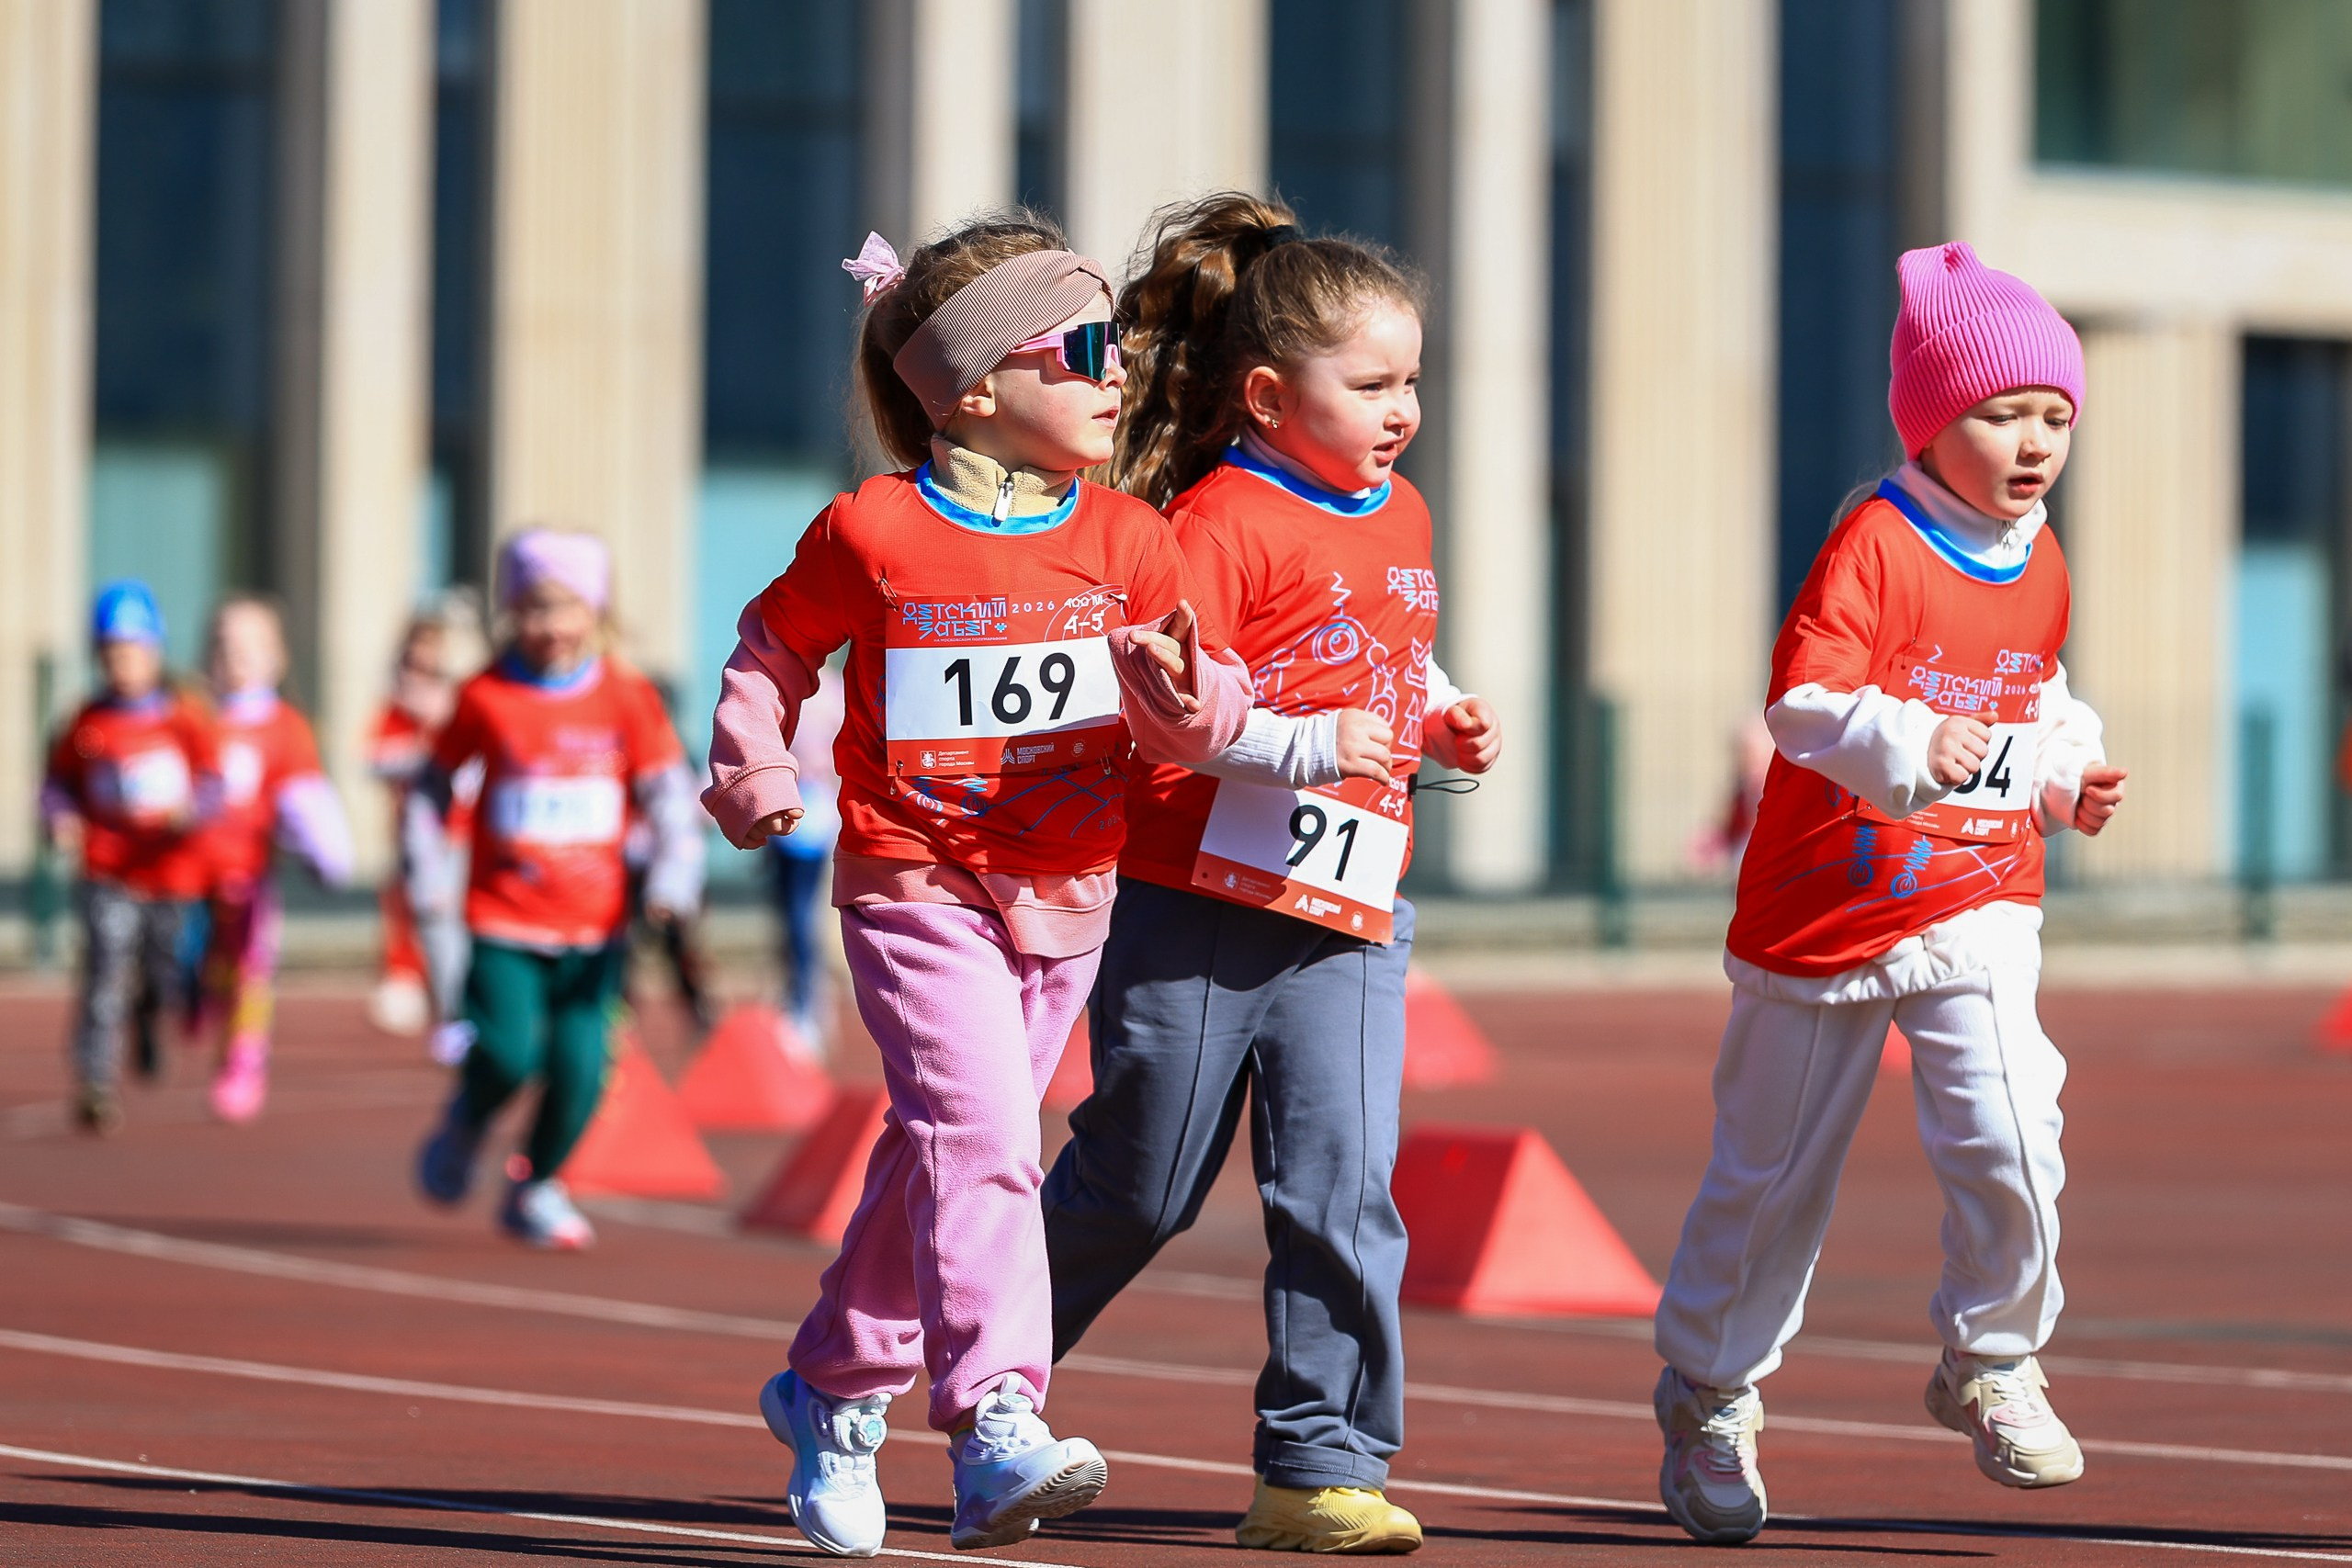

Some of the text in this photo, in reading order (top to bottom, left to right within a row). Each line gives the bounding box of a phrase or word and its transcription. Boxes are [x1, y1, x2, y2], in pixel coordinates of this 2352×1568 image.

[902, 597, 1055, 625] ДЕТСКИЙ 2026
[1064, 597, 1090, 608] 400
[919, 619, 992, 640] ЗАБЕГ
[944, 652, 1076, 727] 169
[1908, 665, 2003, 697] ДЕТСКИЙ
[2005, 684, 2026, 695] 2026
[1017, 754, 1036, 764] СПОРТ
[1285, 804, 1360, 882] 91
